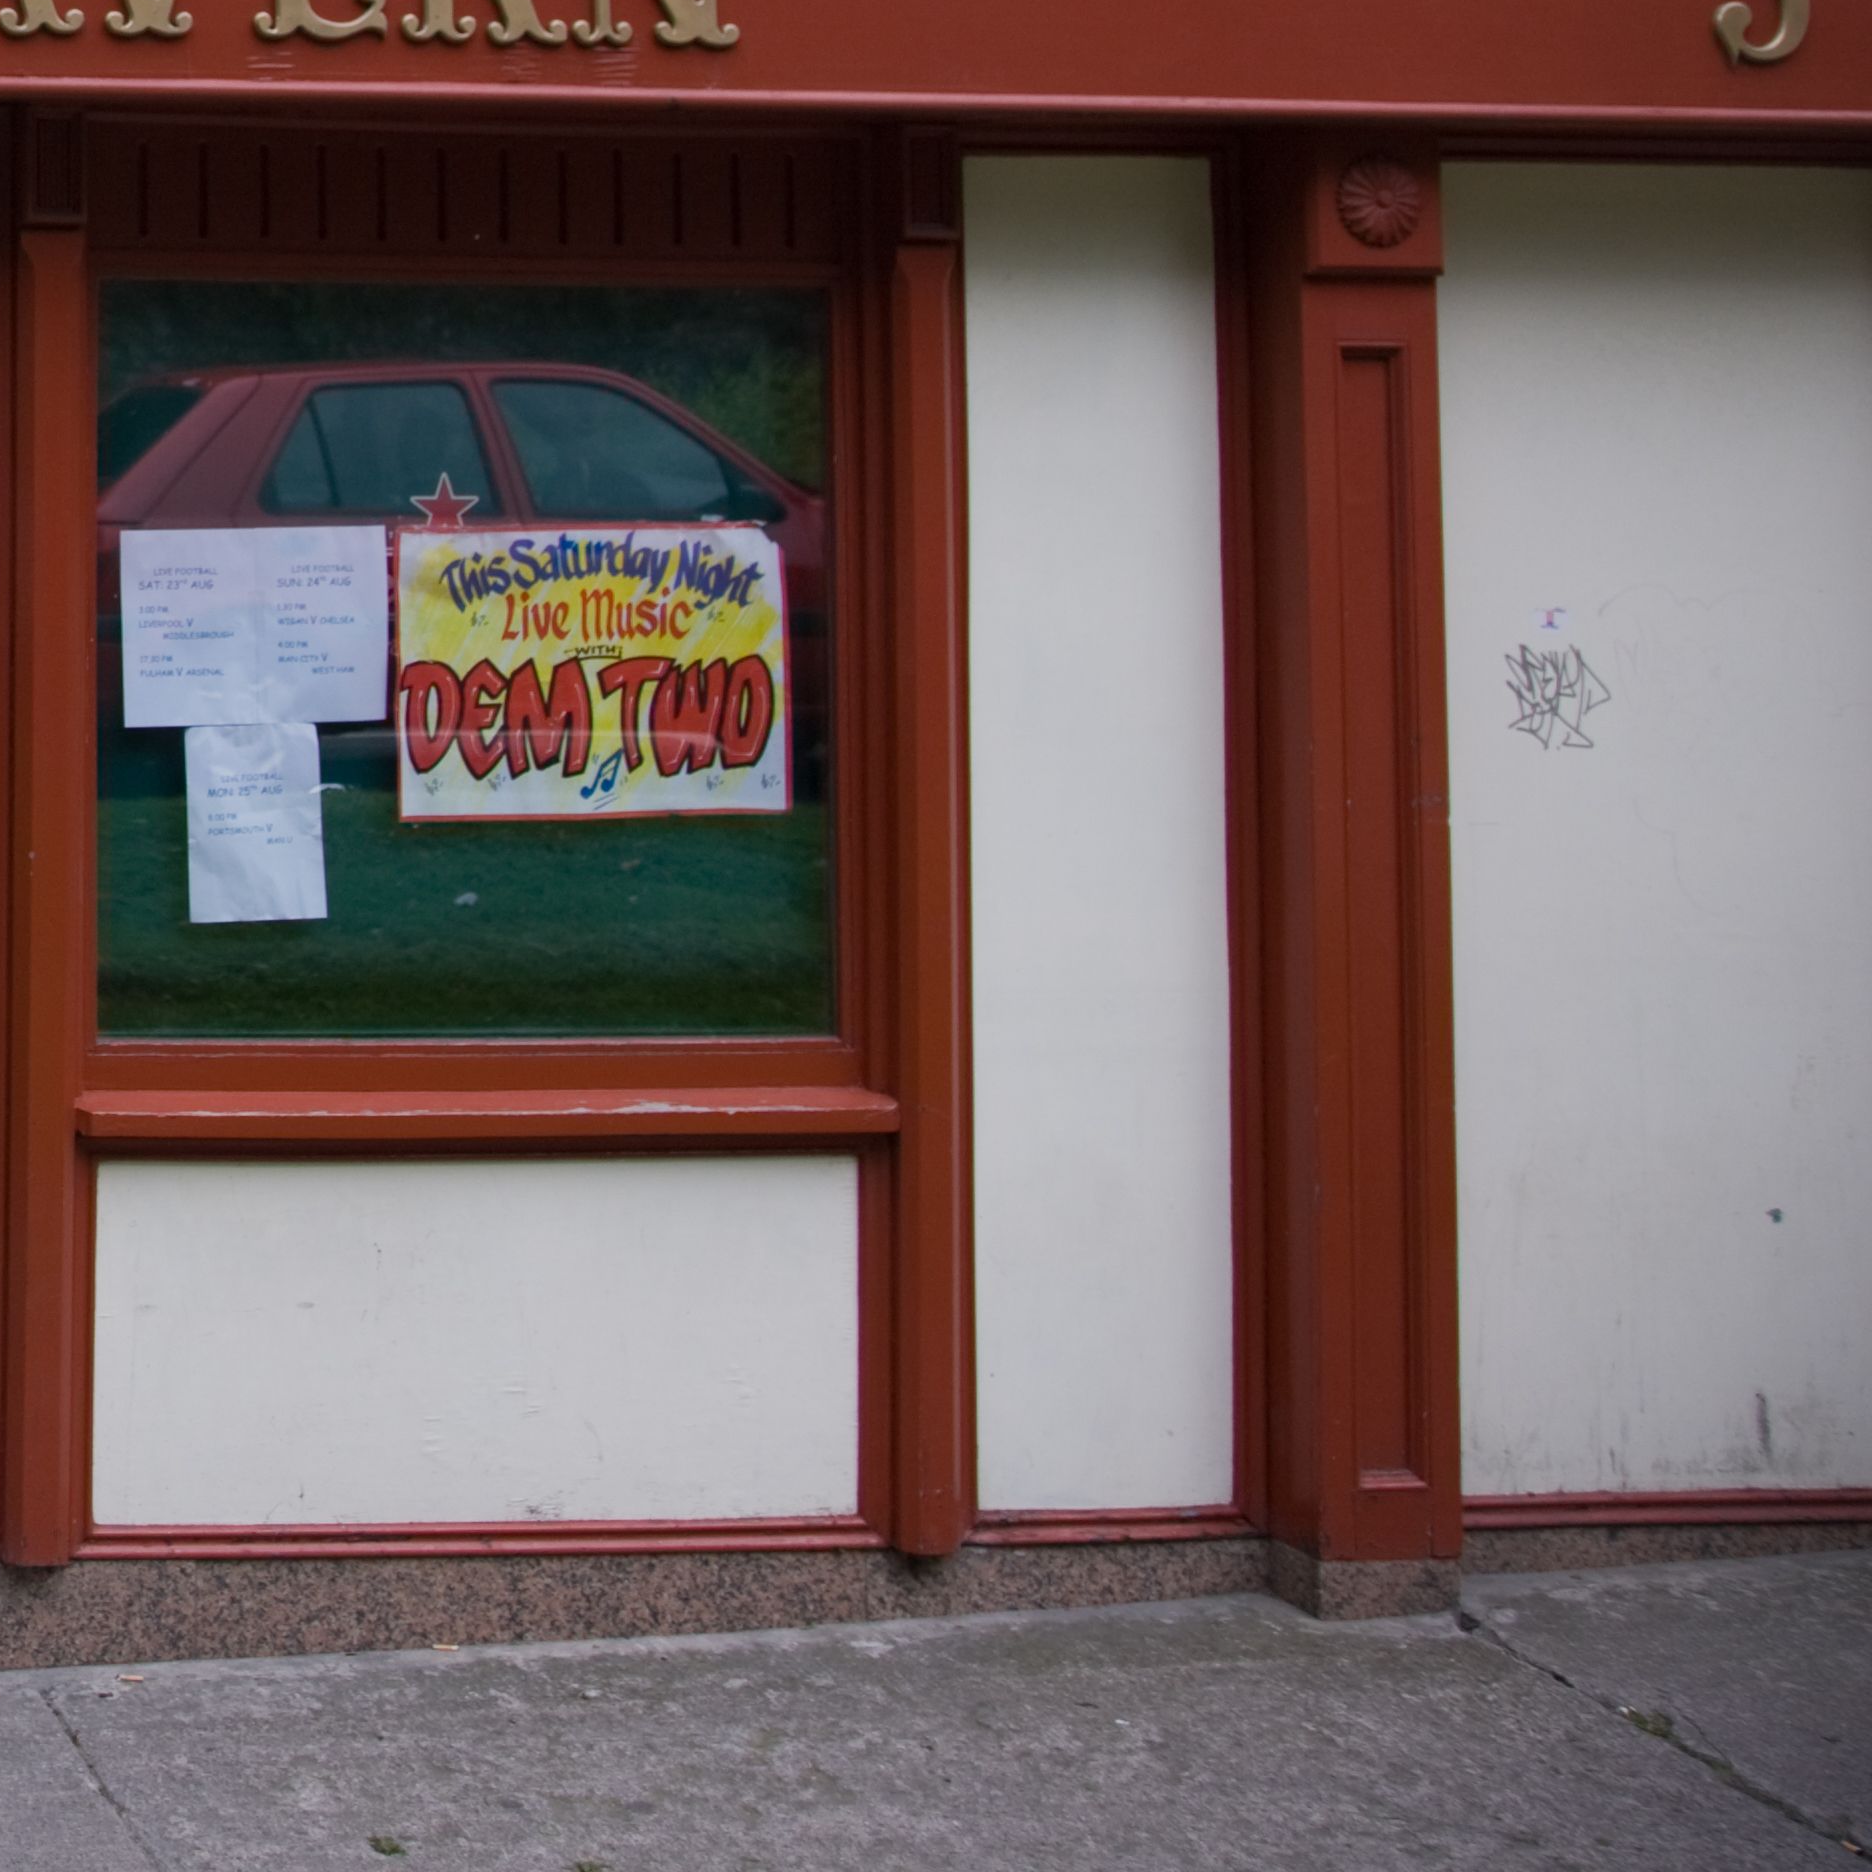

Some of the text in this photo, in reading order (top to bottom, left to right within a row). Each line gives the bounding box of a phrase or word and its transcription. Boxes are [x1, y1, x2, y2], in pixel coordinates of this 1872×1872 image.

[175, 567, 219, 576] FOOTBALL
[312, 564, 355, 573] FOOTBALL
[439, 531, 764, 613] This Saturday Night
[191, 578, 214, 590] AUG
[329, 576, 352, 587] AUG
[501, 587, 695, 643] Live Music
[400, 654, 776, 780] DEM TWO
